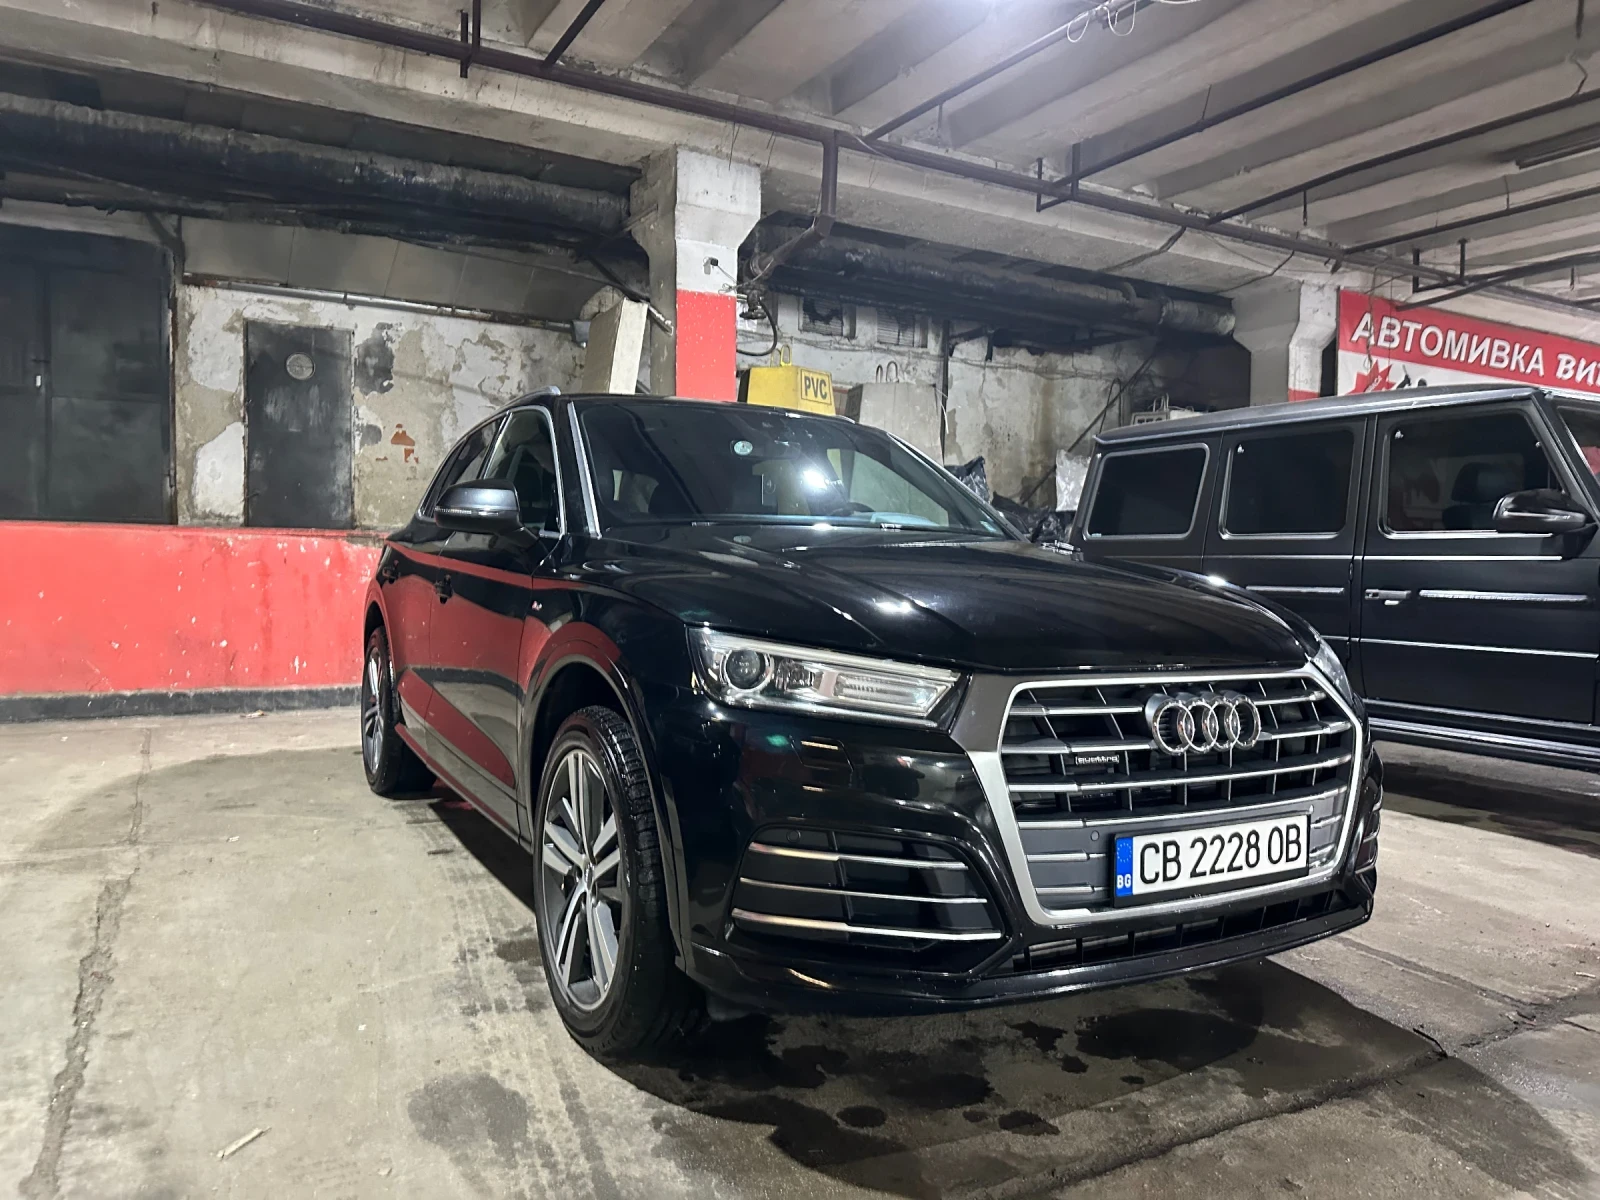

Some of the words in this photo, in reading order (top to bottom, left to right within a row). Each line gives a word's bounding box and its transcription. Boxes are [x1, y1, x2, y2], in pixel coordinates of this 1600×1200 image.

[1350, 311, 1545, 378] АВТОМИВКА
[804, 375, 828, 400] PVC
[1139, 840, 1182, 885] CB
[1189, 829, 1261, 879] 2228
[1116, 874, 1132, 889] BG
